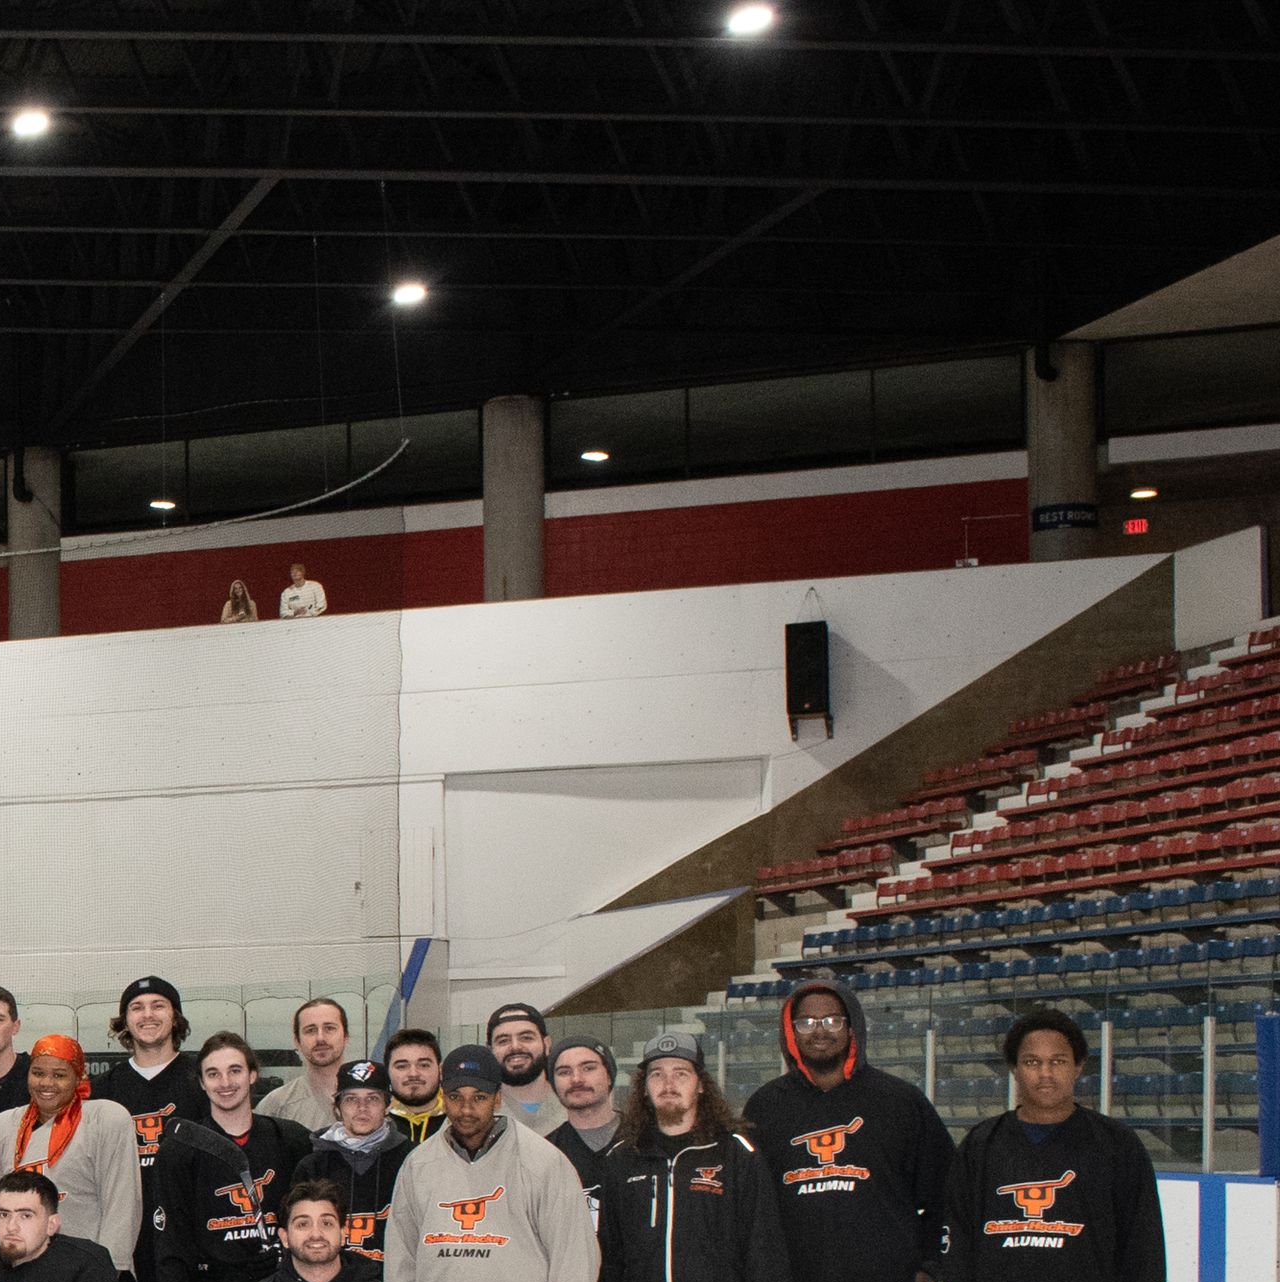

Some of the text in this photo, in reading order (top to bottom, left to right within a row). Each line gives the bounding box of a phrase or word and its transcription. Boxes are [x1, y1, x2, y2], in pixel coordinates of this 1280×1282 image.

[798, 1181, 855, 1195] ALUMNI
[1003, 1236, 1064, 1248] ALUMNI
[437, 1249, 491, 1259] ALUMNI
